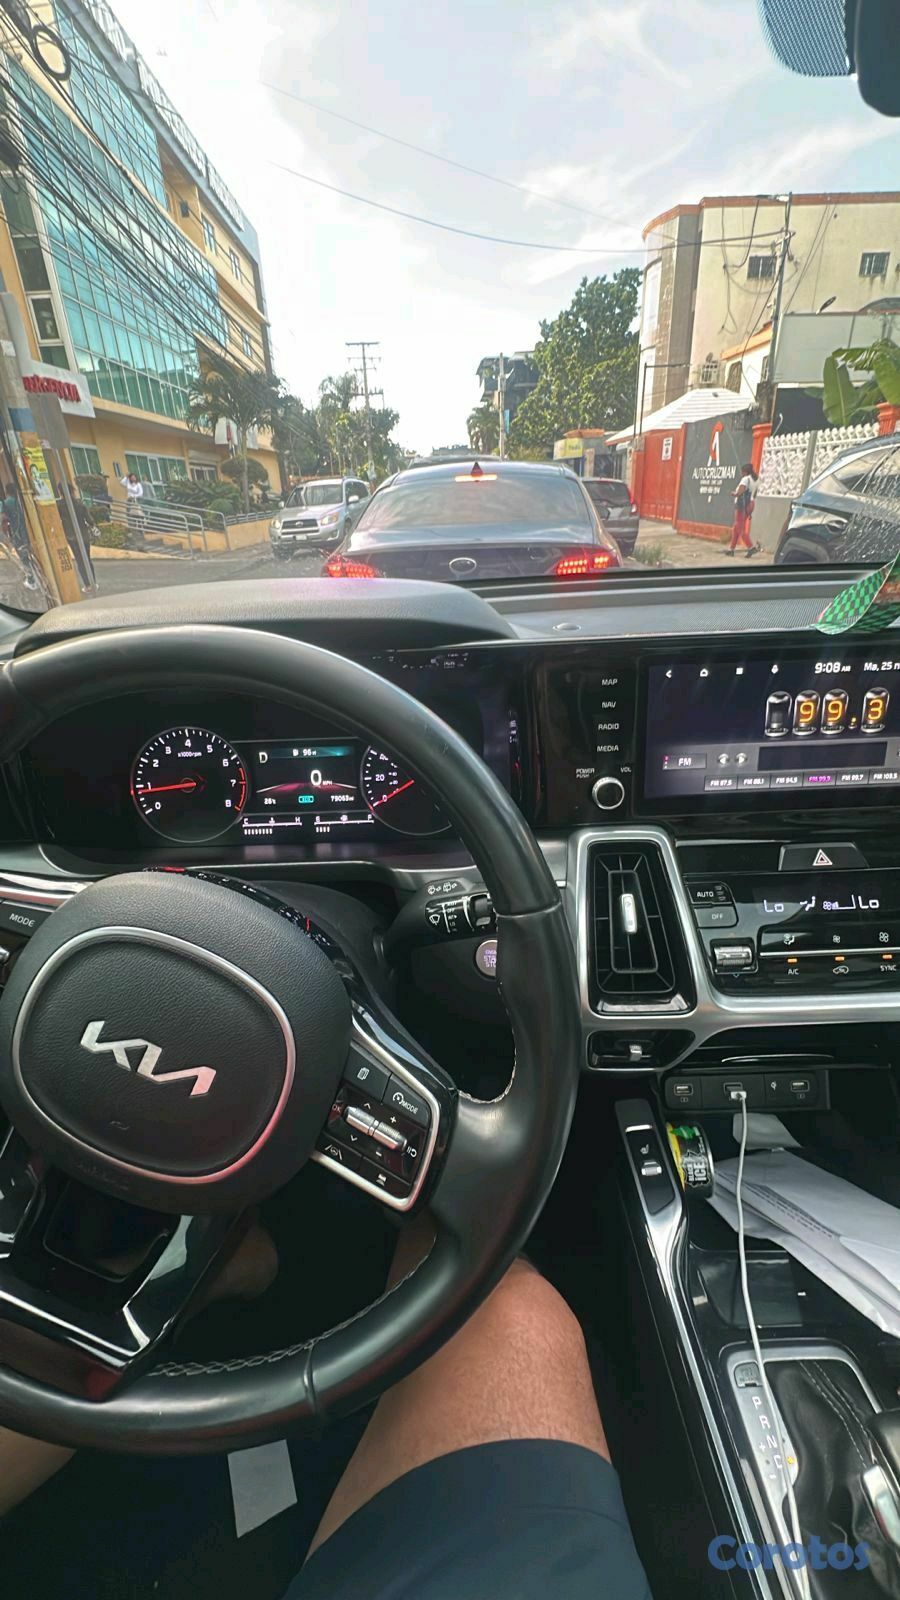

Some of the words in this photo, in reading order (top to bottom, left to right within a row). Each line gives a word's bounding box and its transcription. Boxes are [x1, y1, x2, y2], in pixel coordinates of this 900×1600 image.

[815, 662, 841, 674] 9:08
[864, 662, 879, 672] Ma,
[881, 661, 893, 671] 25
[601, 678, 618, 686] MAP
[601, 701, 617, 709] NAV
[799, 699, 884, 722] 99.3
[598, 723, 620, 731] RADIO
[184, 739, 192, 748] 4
[165, 746, 172, 755] 3
[206, 745, 214, 753] 5
[596, 744, 619, 753] MEDIA
[259, 751, 268, 764] D
[678, 757, 692, 767] FM
[152, 759, 159, 768] 2
[222, 759, 229, 767] 6
[310, 769, 322, 786] 0
[375, 774, 385, 782] 20
[230, 779, 237, 788] 7
[382, 794, 388, 802] 0
[154, 802, 161, 810] 0
[225, 799, 232, 807] 8
[9, 912, 36, 928] MODE
[787, 968, 800, 976] A/C
[880, 964, 897, 972] SYNC
[332, 1103, 341, 1113] OK
[402, 1101, 418, 1115] MODE
[752, 1396, 763, 1410] P
[759, 1415, 771, 1430] R
[766, 1435, 778, 1449] N
